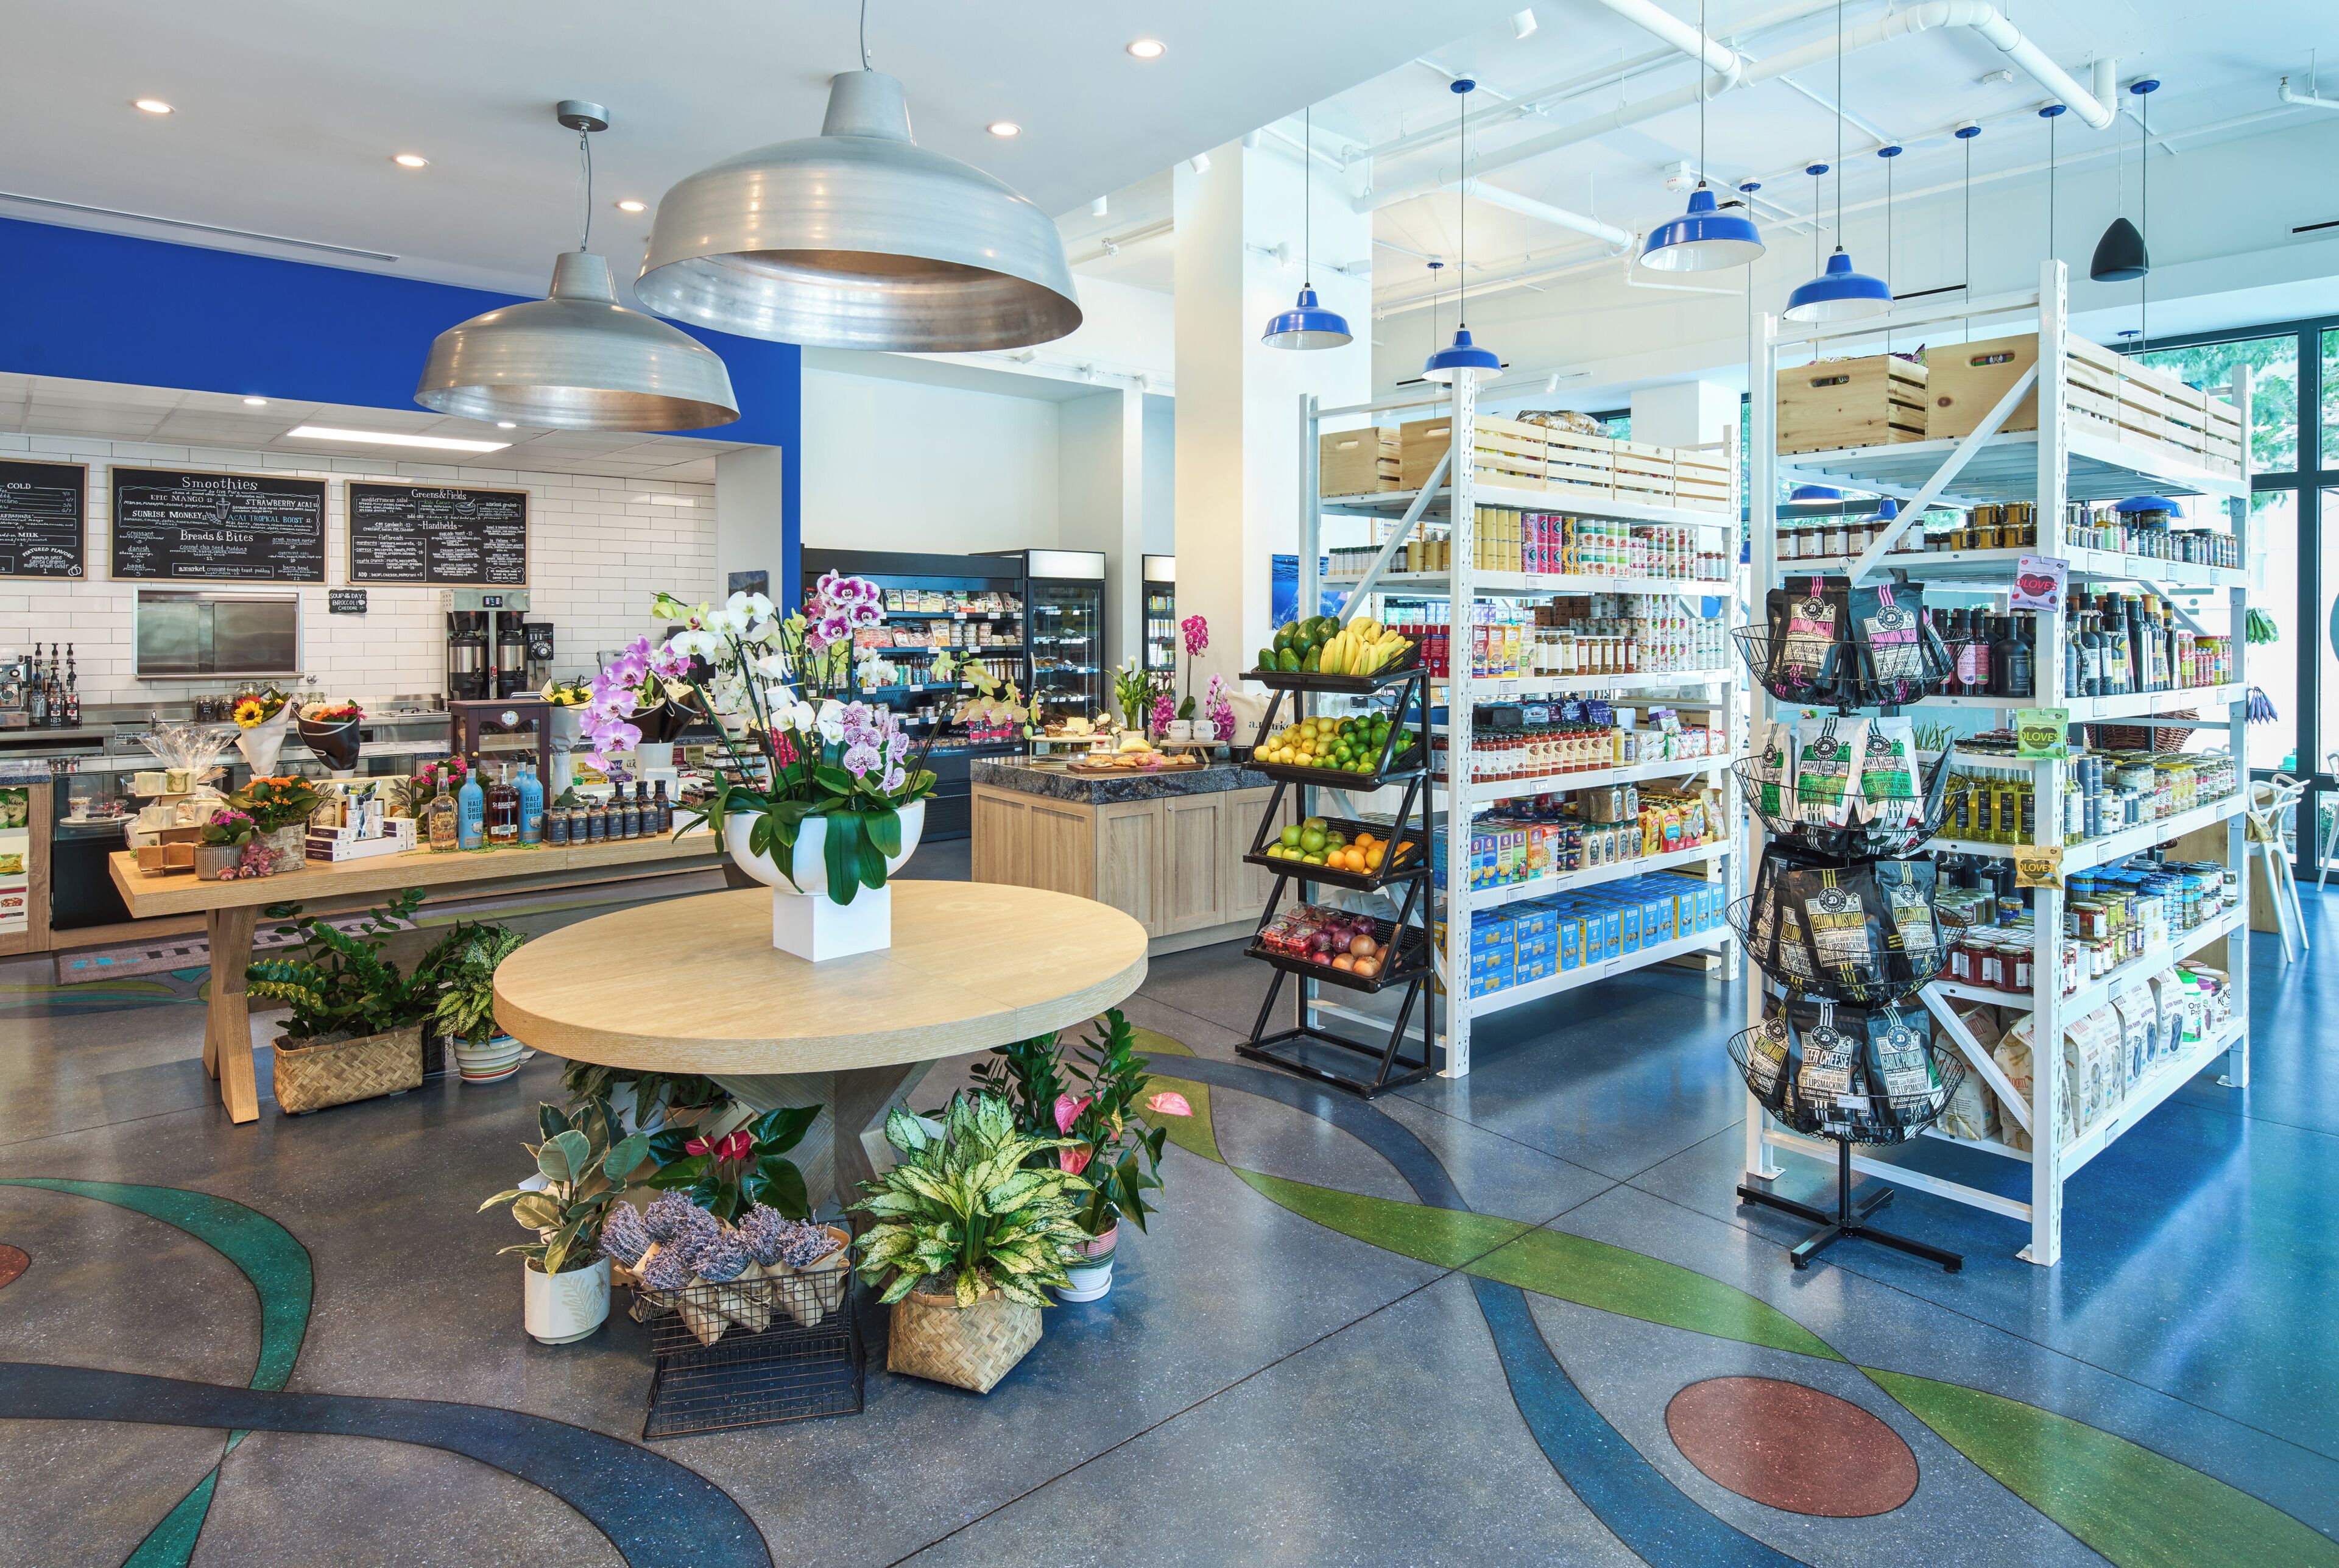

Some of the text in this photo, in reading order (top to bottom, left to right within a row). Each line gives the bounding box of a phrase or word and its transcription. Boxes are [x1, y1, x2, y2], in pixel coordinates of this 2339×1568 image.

[182, 477, 258, 490] Smoothies
[180, 530, 253, 542] Breads & Bites
[22, 547, 75, 559] FEATURED FLAVORS
[2016, 578, 2058, 591] OLOVES
[1886, 607, 1902, 617] DADDY
[1813, 621, 1833, 637] SUGAR
[1824, 737, 1837, 747] DADDY
[1872, 736, 1889, 744] DADDY
[2019, 732, 2062, 743] OLOVES
[1815, 750, 1835, 759] PRETZELS
[1818, 760, 1836, 774] STREET
[1836, 761, 1849, 775] CORN
[1865, 783, 1876, 792] IT'S
[2017, 863, 2055, 873] OLOVES
[1828, 889, 1844, 898] DADDY
[1822, 903, 1844, 912] PRETZELS
[1810, 913, 1863, 930] YELLOW MUSTARD
[1829, 942, 1866, 951] LIPSMACKING
[1823, 1027, 1838, 1039] DADDY
[1896, 1027, 1910, 1036] DADDY
[1816, 1040, 1836, 1050] PRETZELS
[1804, 1048, 1850, 1068] BEER CHEESE
[1882, 1053, 1902, 1070] GARLIC
[1809, 1079, 1846, 1091] LIPSMACKING
[1890, 1084, 1900, 1095] IT'S
